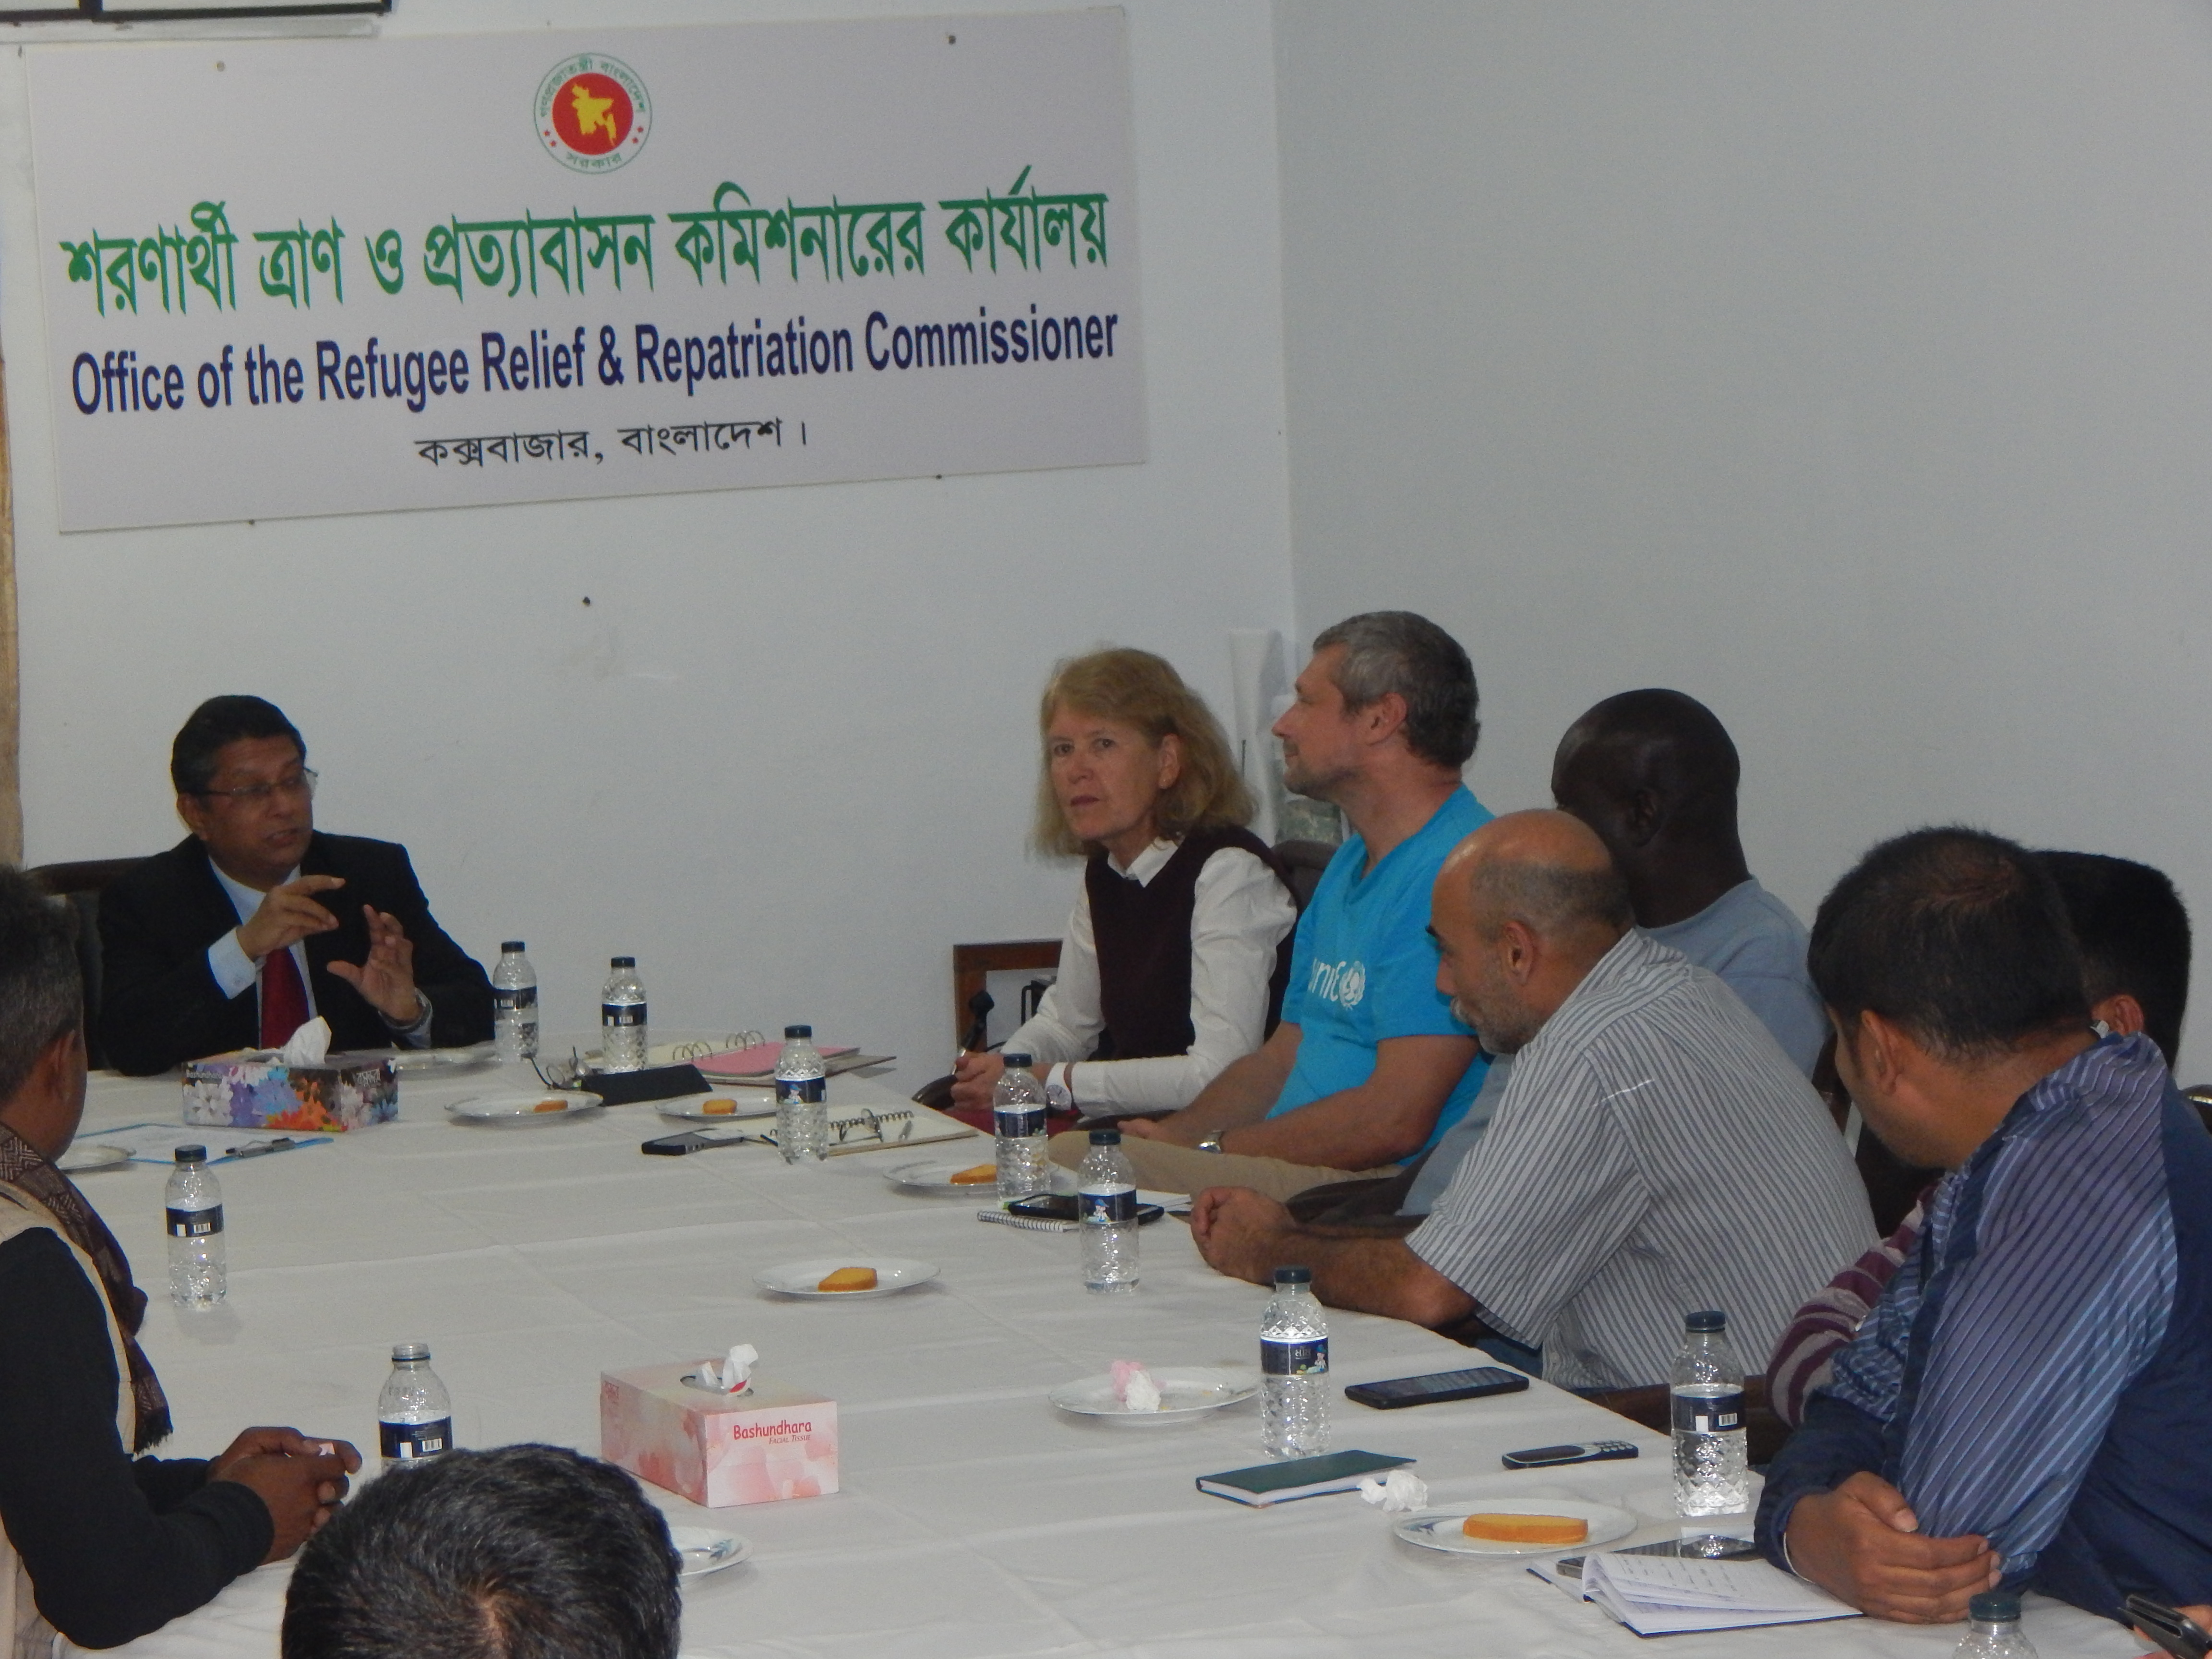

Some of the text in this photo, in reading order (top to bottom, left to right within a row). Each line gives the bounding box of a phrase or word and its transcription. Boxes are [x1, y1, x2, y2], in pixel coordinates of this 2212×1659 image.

[252, 215, 346, 310] ত্রাণ
[365, 228, 405, 295] ও
[423, 205, 657, 304] প্রত্যাবাসন
[667, 181, 926, 287] কমিশনারের
[938, 164, 1109, 276] কার্যালয়
[72, 303, 1118, 416] Office of the Refugee Relief & Repatriation Commissioner
[414, 429, 604, 467] কক্সবাজার,
[617, 416, 782, 456] বাংলাদেশ
[733, 1419, 812, 1440] Bashundhara
